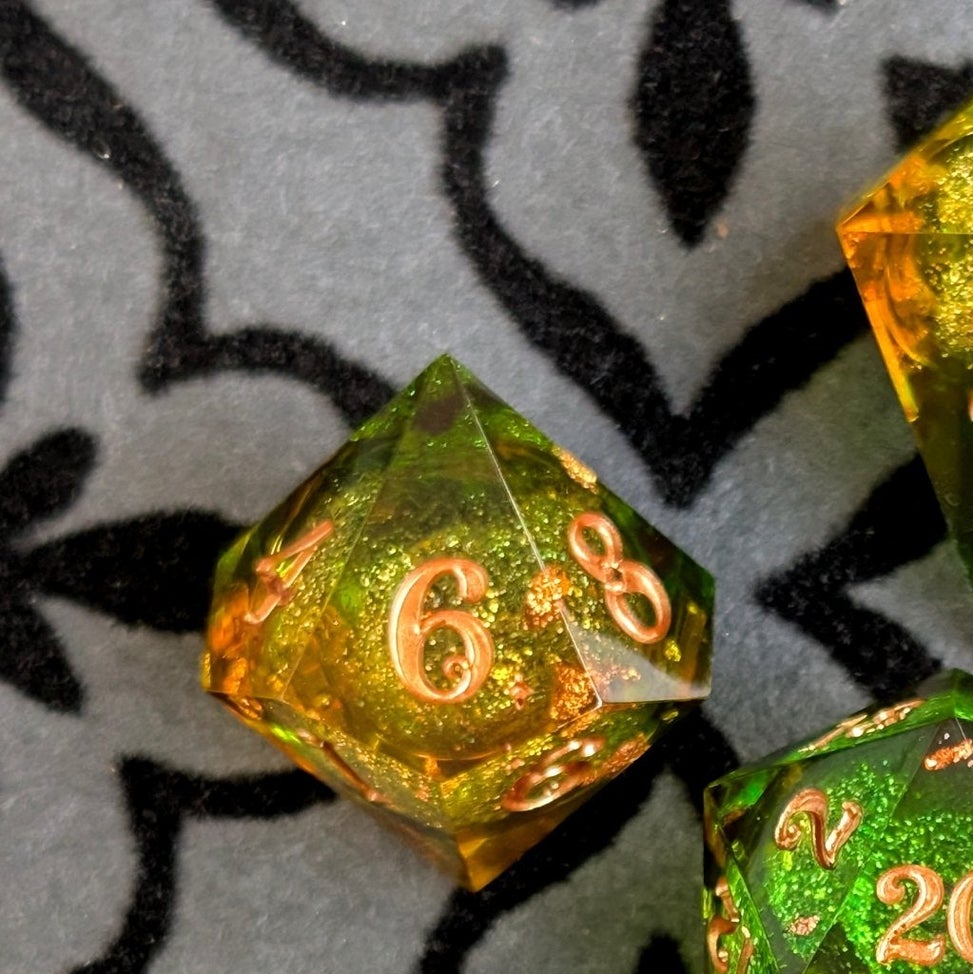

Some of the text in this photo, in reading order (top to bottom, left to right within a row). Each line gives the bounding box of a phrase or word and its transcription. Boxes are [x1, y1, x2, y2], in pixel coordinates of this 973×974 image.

[388, 558, 494, 703] 6
[568, 513, 671, 643] 8
[774, 788, 864, 870] 2
